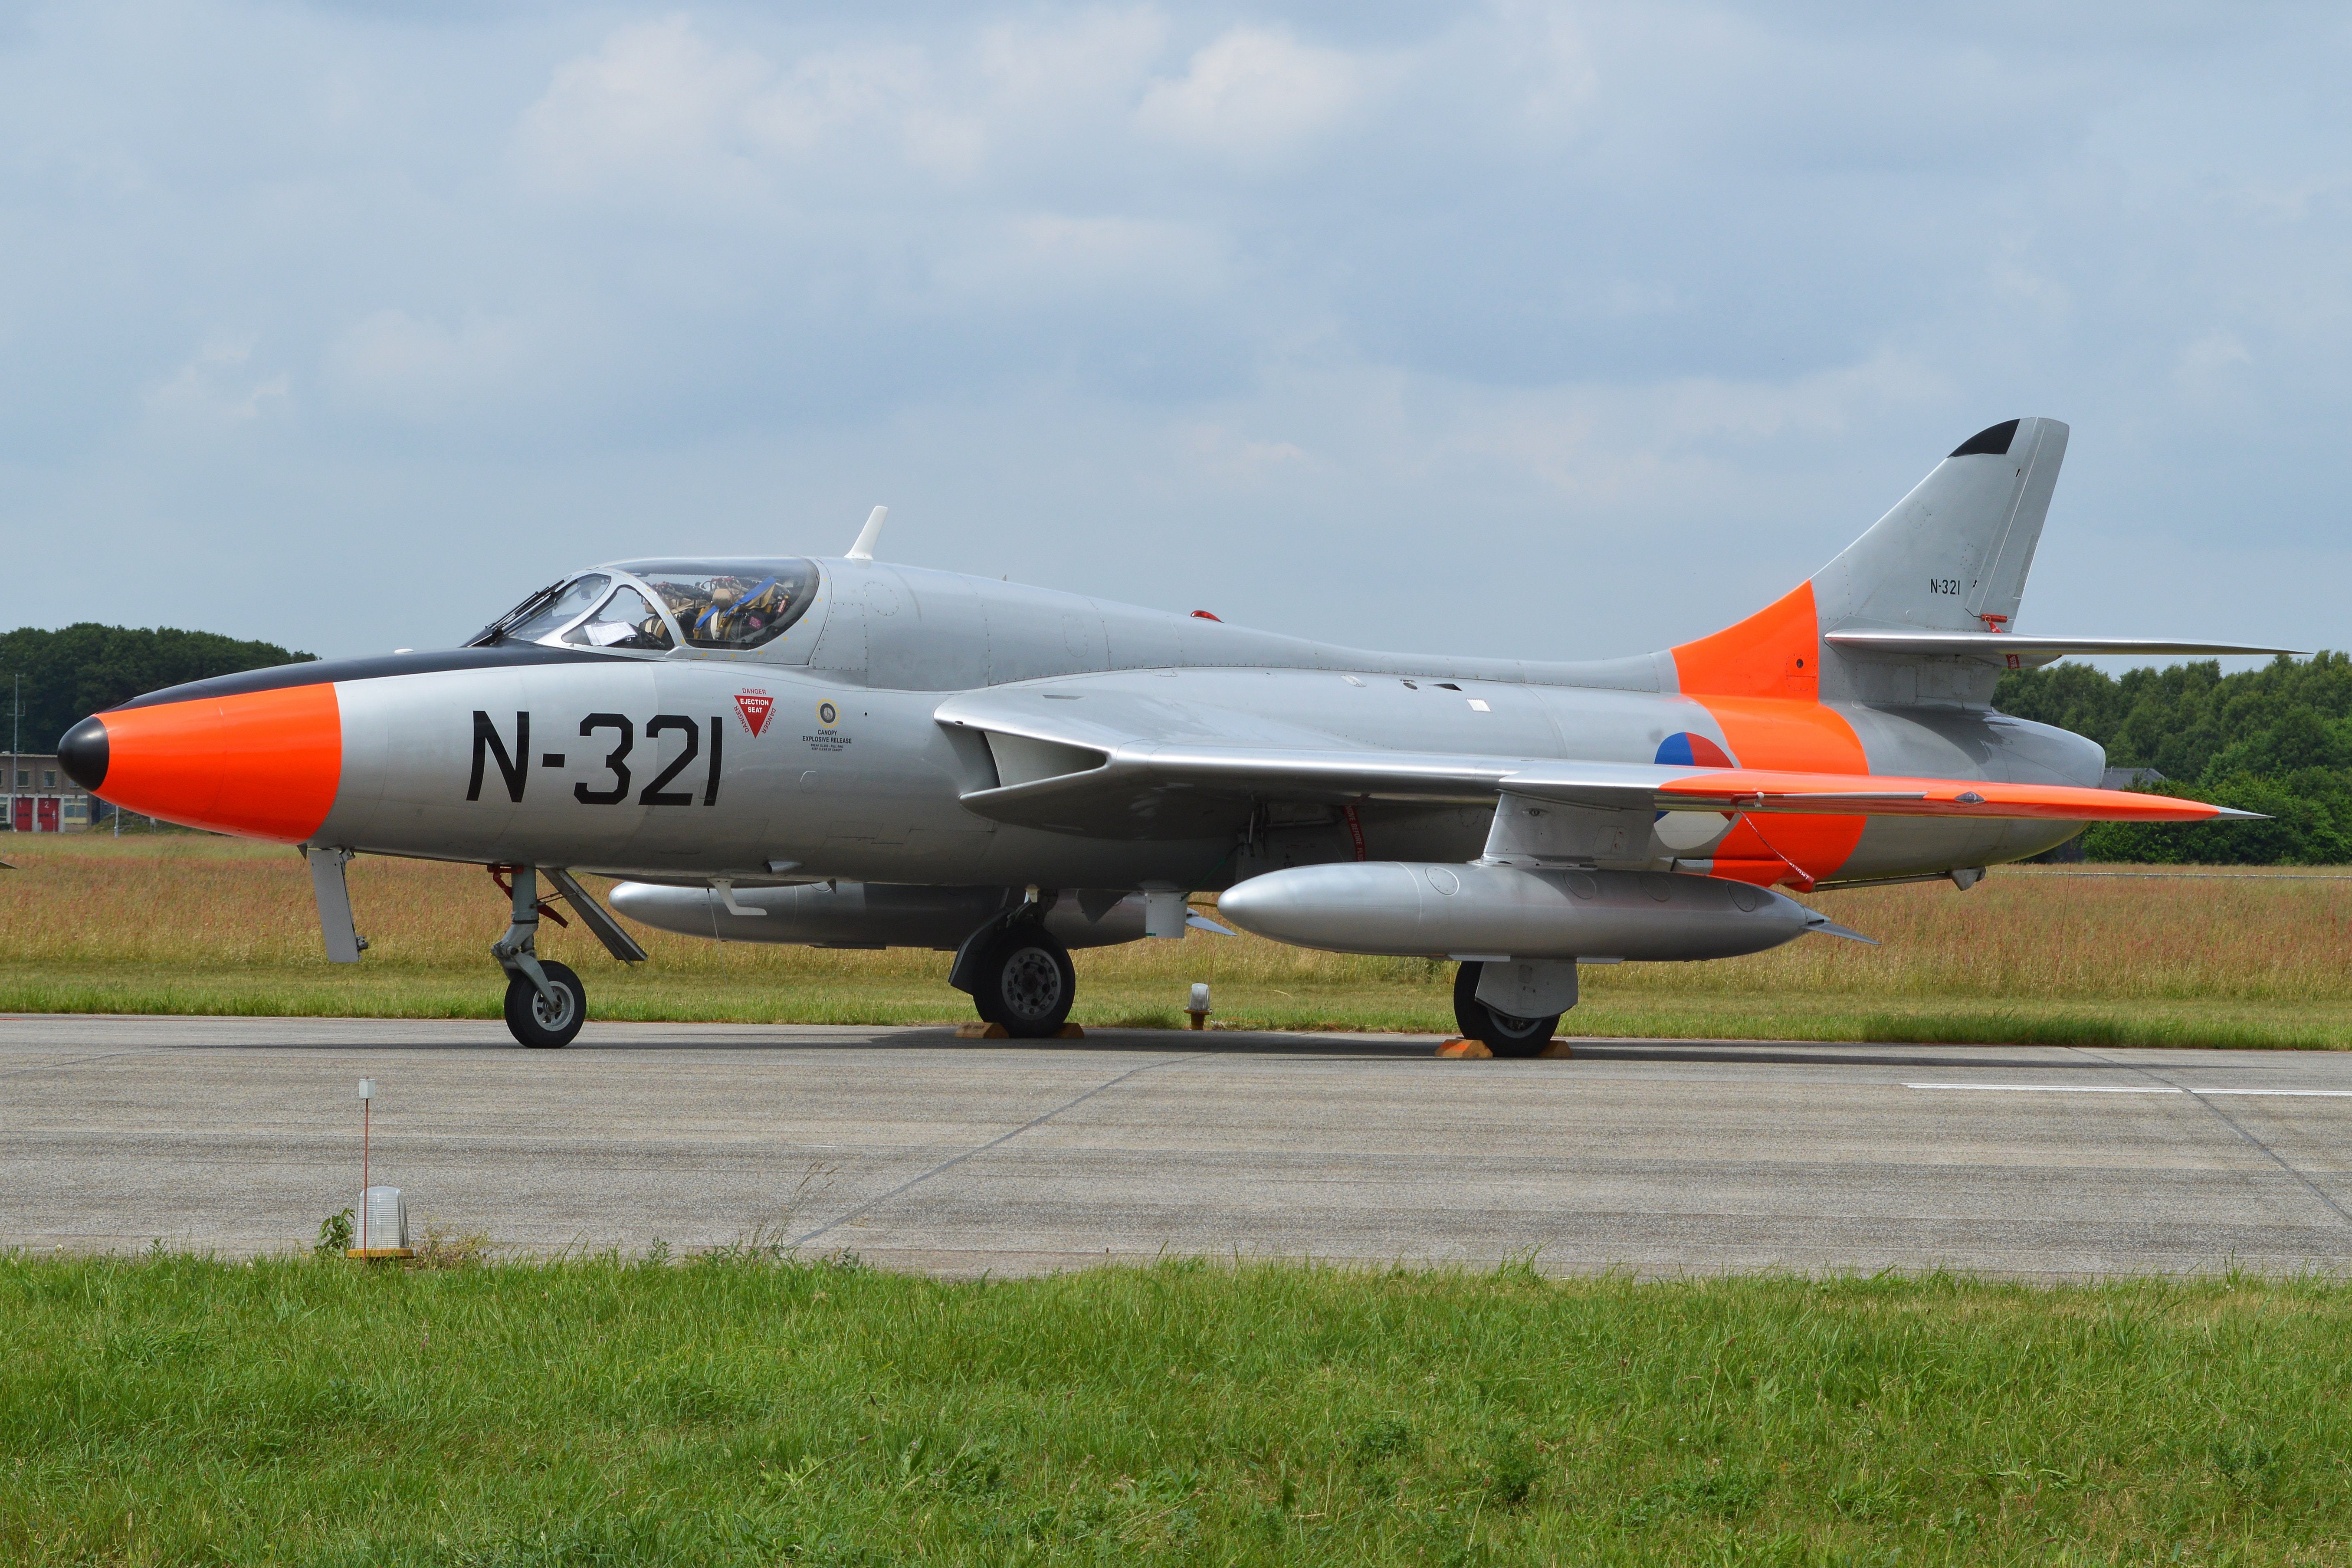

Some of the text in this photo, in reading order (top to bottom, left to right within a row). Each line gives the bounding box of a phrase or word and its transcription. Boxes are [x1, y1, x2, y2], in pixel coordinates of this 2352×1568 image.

[1931, 578, 1960, 595] N-321
[734, 706, 749, 733] DANGER
[761, 708, 776, 734] DANGER
[466, 710, 723, 806] N-321
[1345, 805, 1356, 821] MOVE
[1351, 823, 1362, 845] BEFORE
